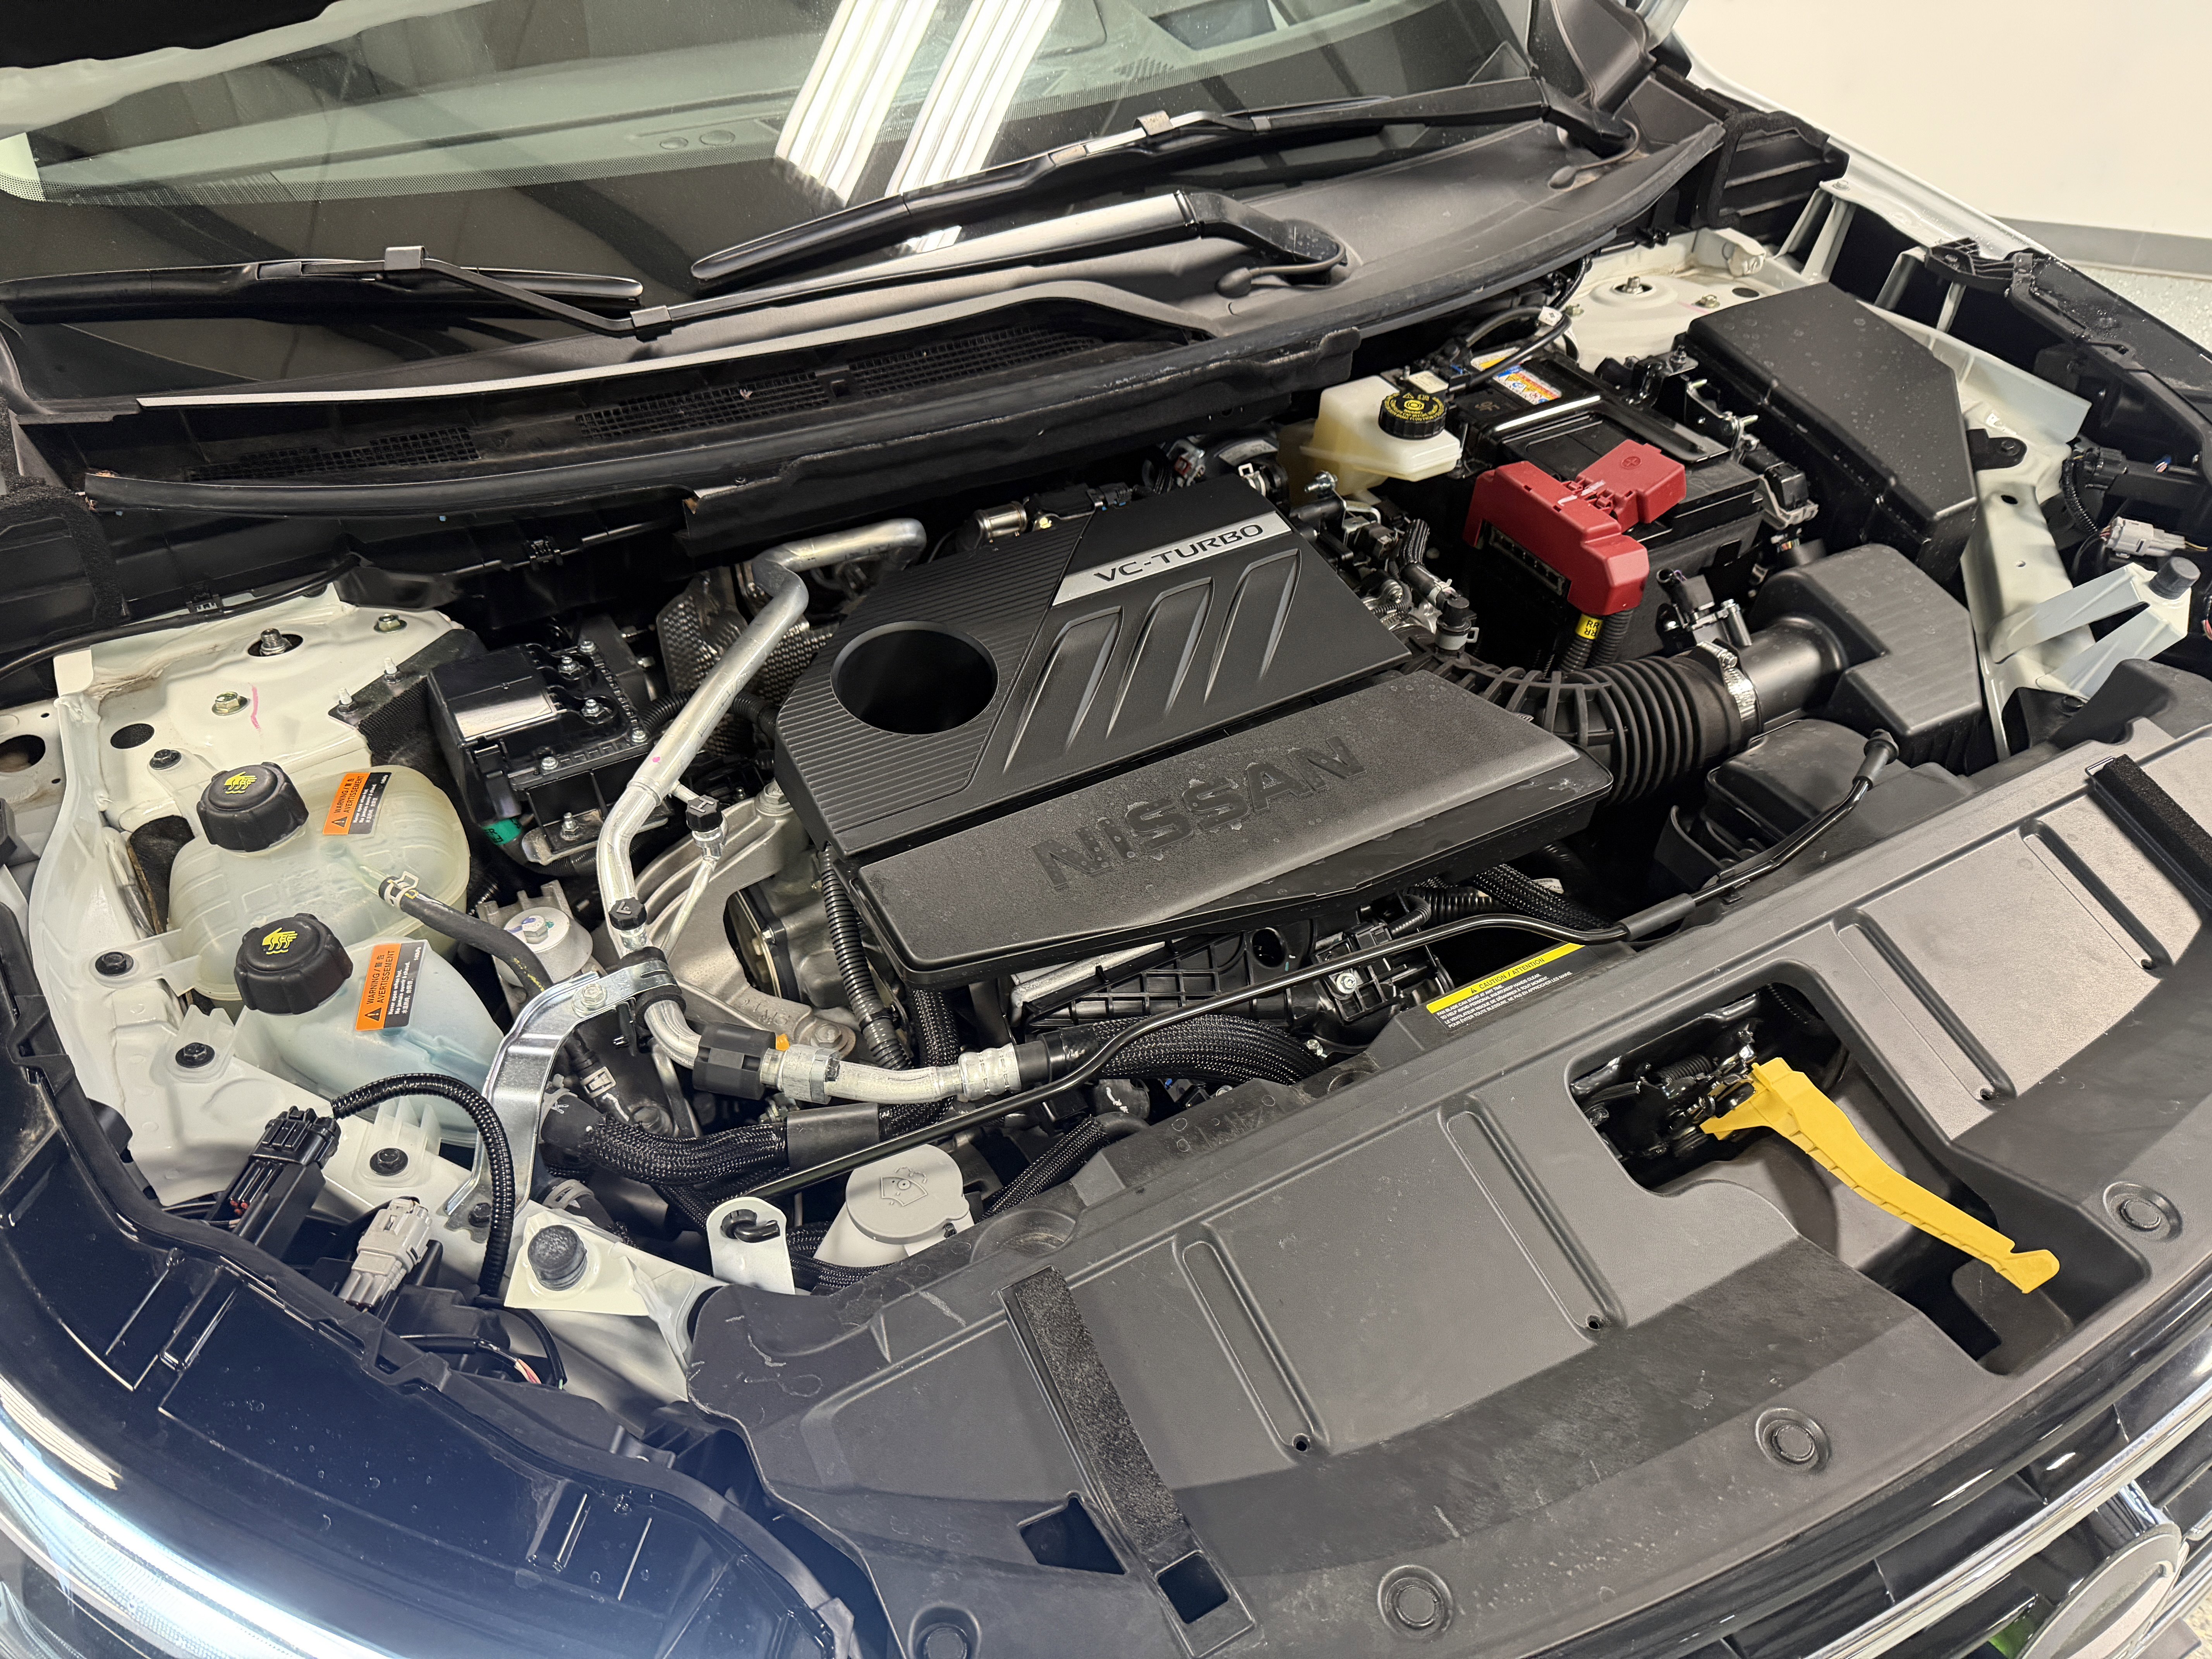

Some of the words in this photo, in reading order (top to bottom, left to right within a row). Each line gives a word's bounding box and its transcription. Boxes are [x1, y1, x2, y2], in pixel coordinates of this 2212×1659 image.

[1093, 524, 1263, 582] VC-TURBO
[1584, 628, 1598, 637] RR
[1586, 620, 1600, 629] RR
[334, 791, 349, 812] WARNING
[343, 776, 364, 812] AVERTISSEMENT
[690, 797, 714, 813] H
[1029, 736, 1366, 890] NISSAN
[616, 901, 632, 914] L
[366, 974, 380, 1004] WARNING
[376, 951, 395, 1003] AVERTISSEMENT
[1479, 974, 1507, 989] CAUTION
[1511, 957, 1545, 975] ATTENTION
[1449, 1008, 1476, 1022] VENTILATEUR
[1475, 1001, 1491, 1011] RISQUE
[1495, 989, 1518, 1001] DÉMARRER
[1530, 975, 1549, 986] MOMENT.
[1459, 1014, 1475, 1023] ÉVITER
[1473, 1009, 1487, 1017] TOUTE
[1527, 979, 1553, 993] APPROCHER
[1559, 970, 1573, 979] MAINS.
[1469, 995, 1491, 1007] PERSONAL
[1513, 979, 1528, 988] HANDS
[1527, 973, 1542, 981] CLEAR.
[1445, 1004, 1459, 1012] BLADE
